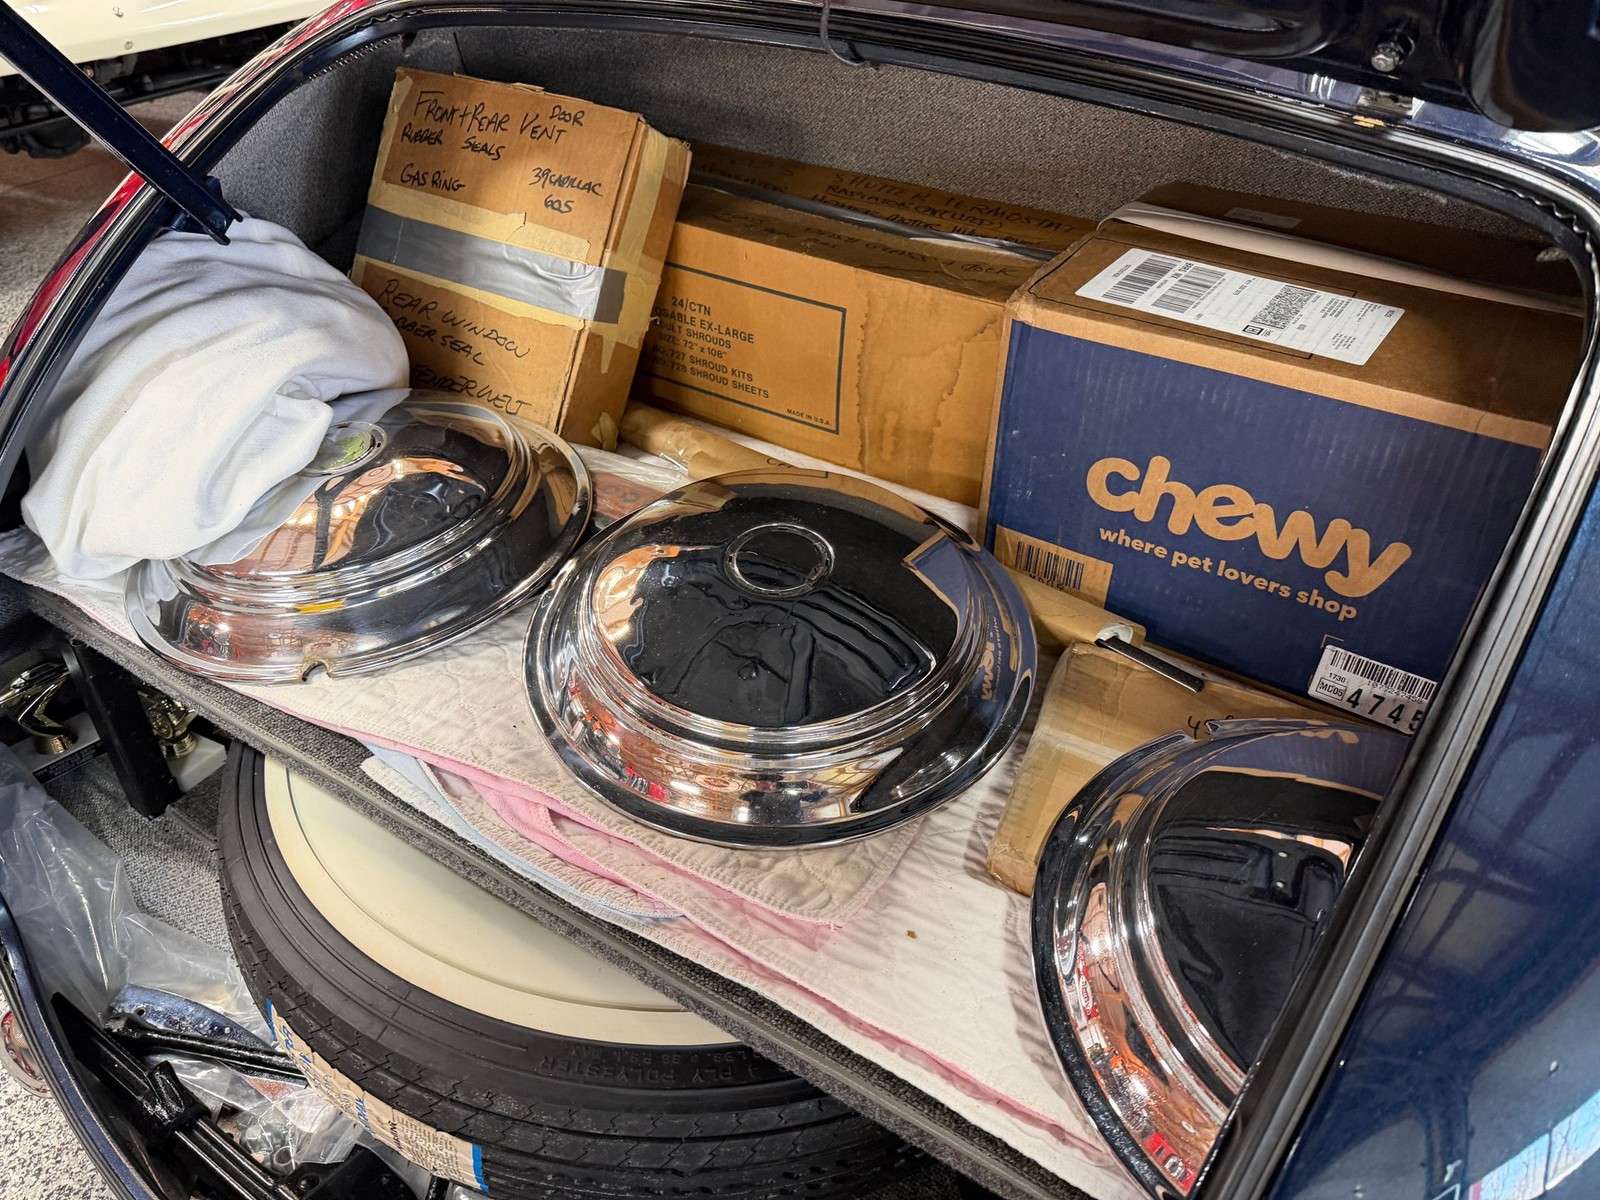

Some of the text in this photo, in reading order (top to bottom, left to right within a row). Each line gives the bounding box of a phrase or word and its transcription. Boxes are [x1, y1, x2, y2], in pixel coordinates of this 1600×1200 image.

[519, 112, 567, 144] VENT
[549, 104, 585, 127] DOOR
[461, 136, 505, 160] SEALS
[400, 162, 428, 186] GAS
[378, 279, 531, 358] REAR WINDOW
[671, 295, 712, 317] 24/CTN
[653, 306, 755, 344] OSABLE EX-LARGE
[686, 326, 732, 350] SHROUDS
[440, 335, 485, 366] SEAL
[689, 353, 728, 374] SHROUD
[731, 367, 754, 382] KITS
[690, 367, 729, 387] SHROUD
[732, 380, 770, 400] SHEETS
[786, 407, 832, 427] MADE IN U.S.A.
[1086, 455, 1412, 598] chewy
[1098, 527, 1358, 622] where pet lovers shop
[1328, 672, 1346, 684] 1730
[540, 1055, 677, 1083] POLYESTER
